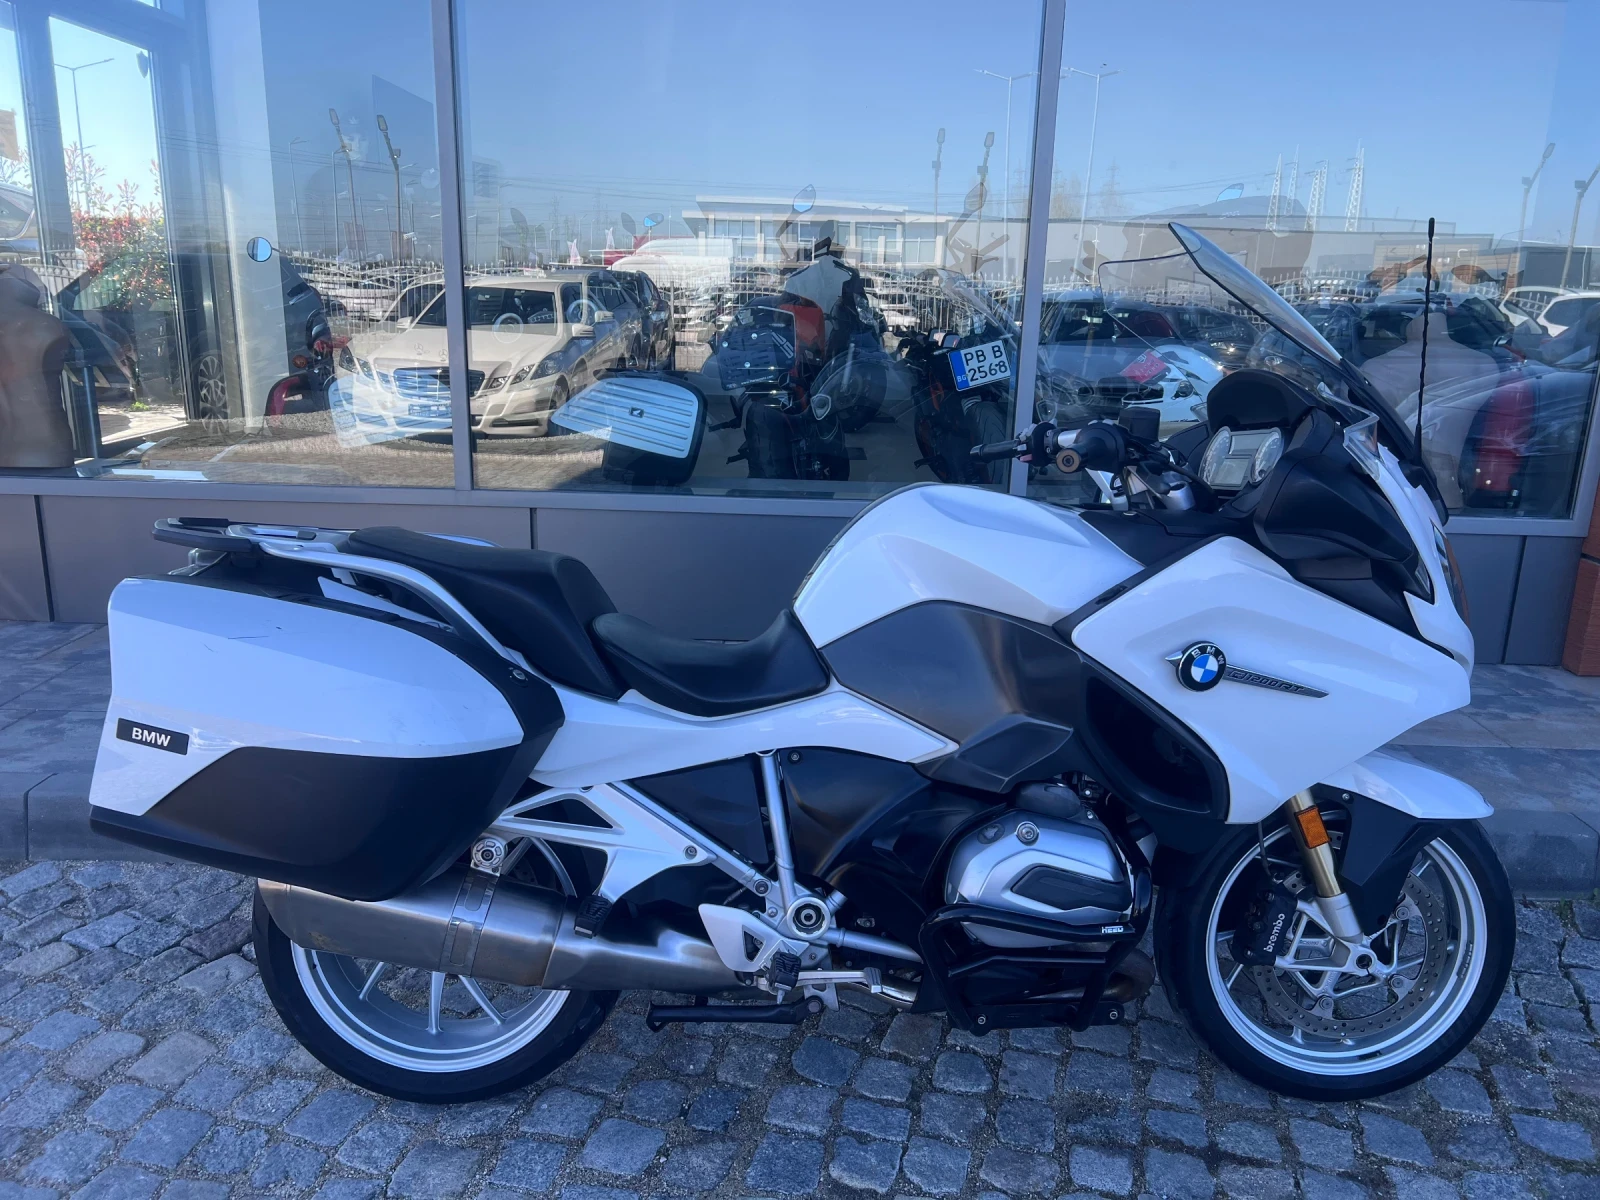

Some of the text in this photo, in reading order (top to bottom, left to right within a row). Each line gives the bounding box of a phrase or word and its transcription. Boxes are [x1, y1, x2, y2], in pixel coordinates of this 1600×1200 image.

[964, 344, 1004, 366] PB B
[957, 374, 967, 383] BG
[967, 360, 1008, 382] 2568
[1191, 645, 1225, 665] BMW
[131, 727, 171, 747] BMW
[1263, 913, 1286, 953] brembo
